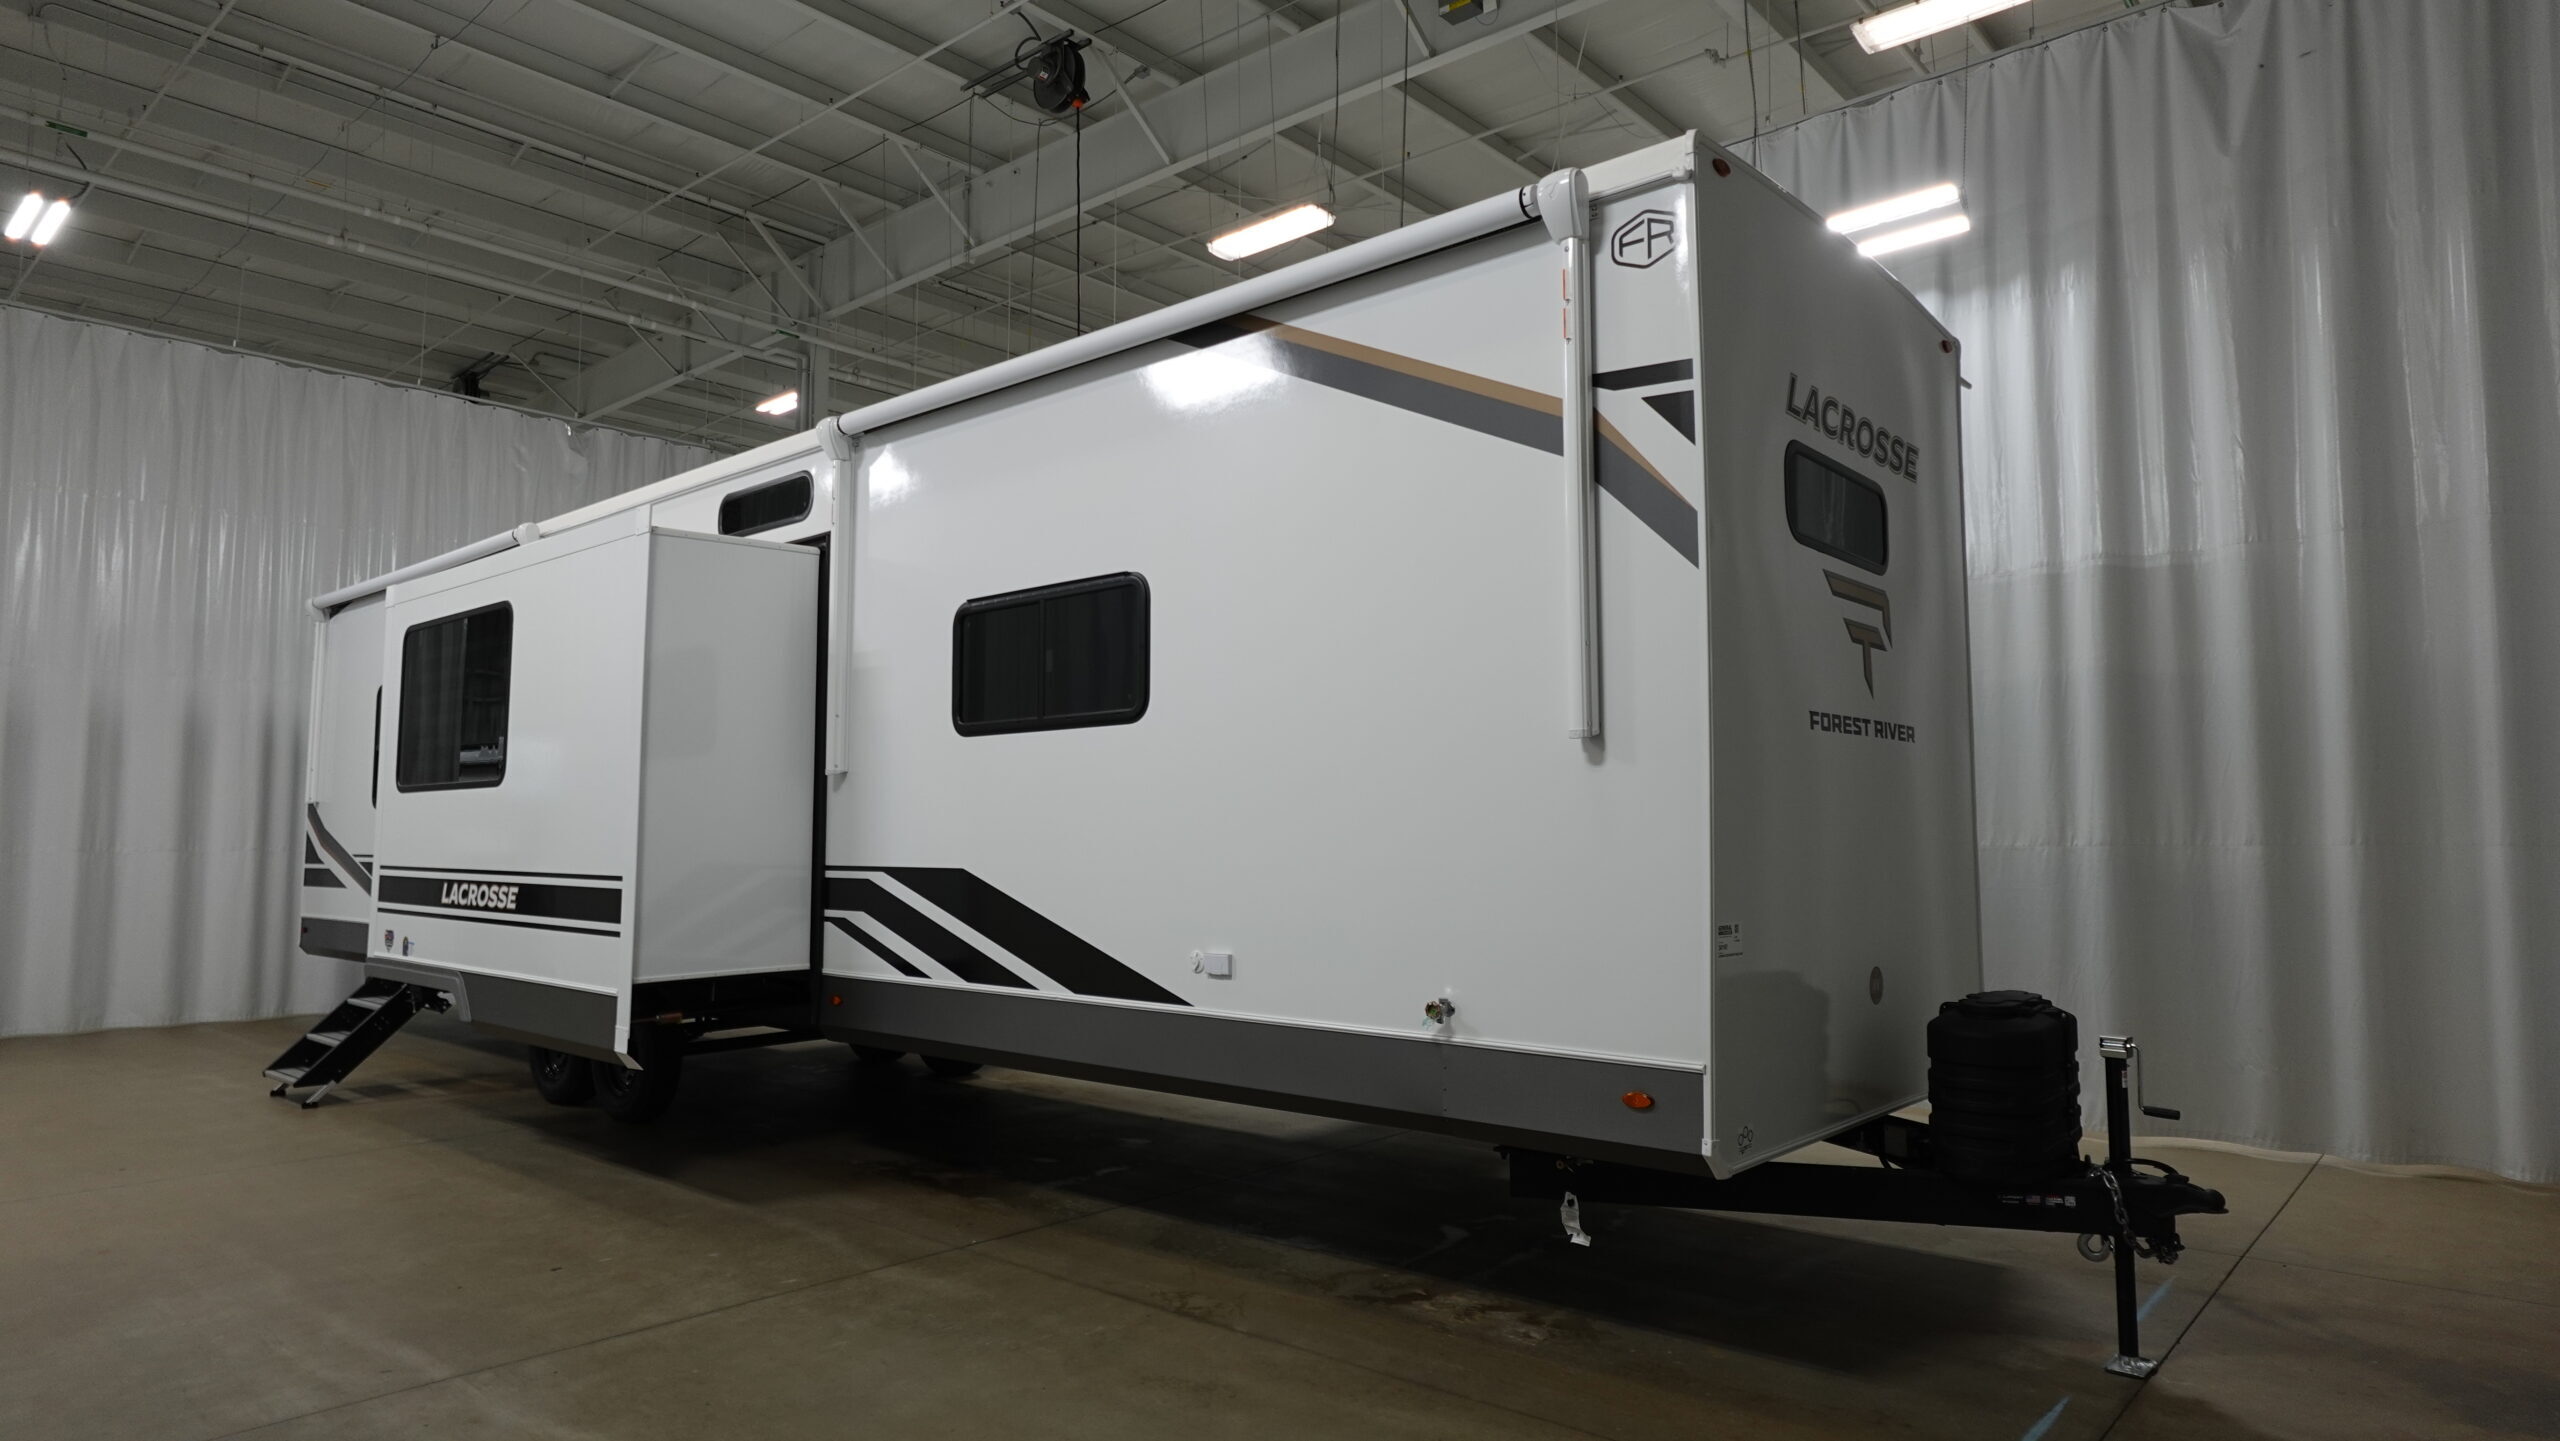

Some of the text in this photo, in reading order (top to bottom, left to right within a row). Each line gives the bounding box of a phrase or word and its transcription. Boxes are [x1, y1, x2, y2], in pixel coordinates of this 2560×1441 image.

[1785, 372, 1920, 483] LACROSSE
[1809, 710, 1915, 743] FOREST RIVER
[441, 882, 519, 910] LACROSSE
